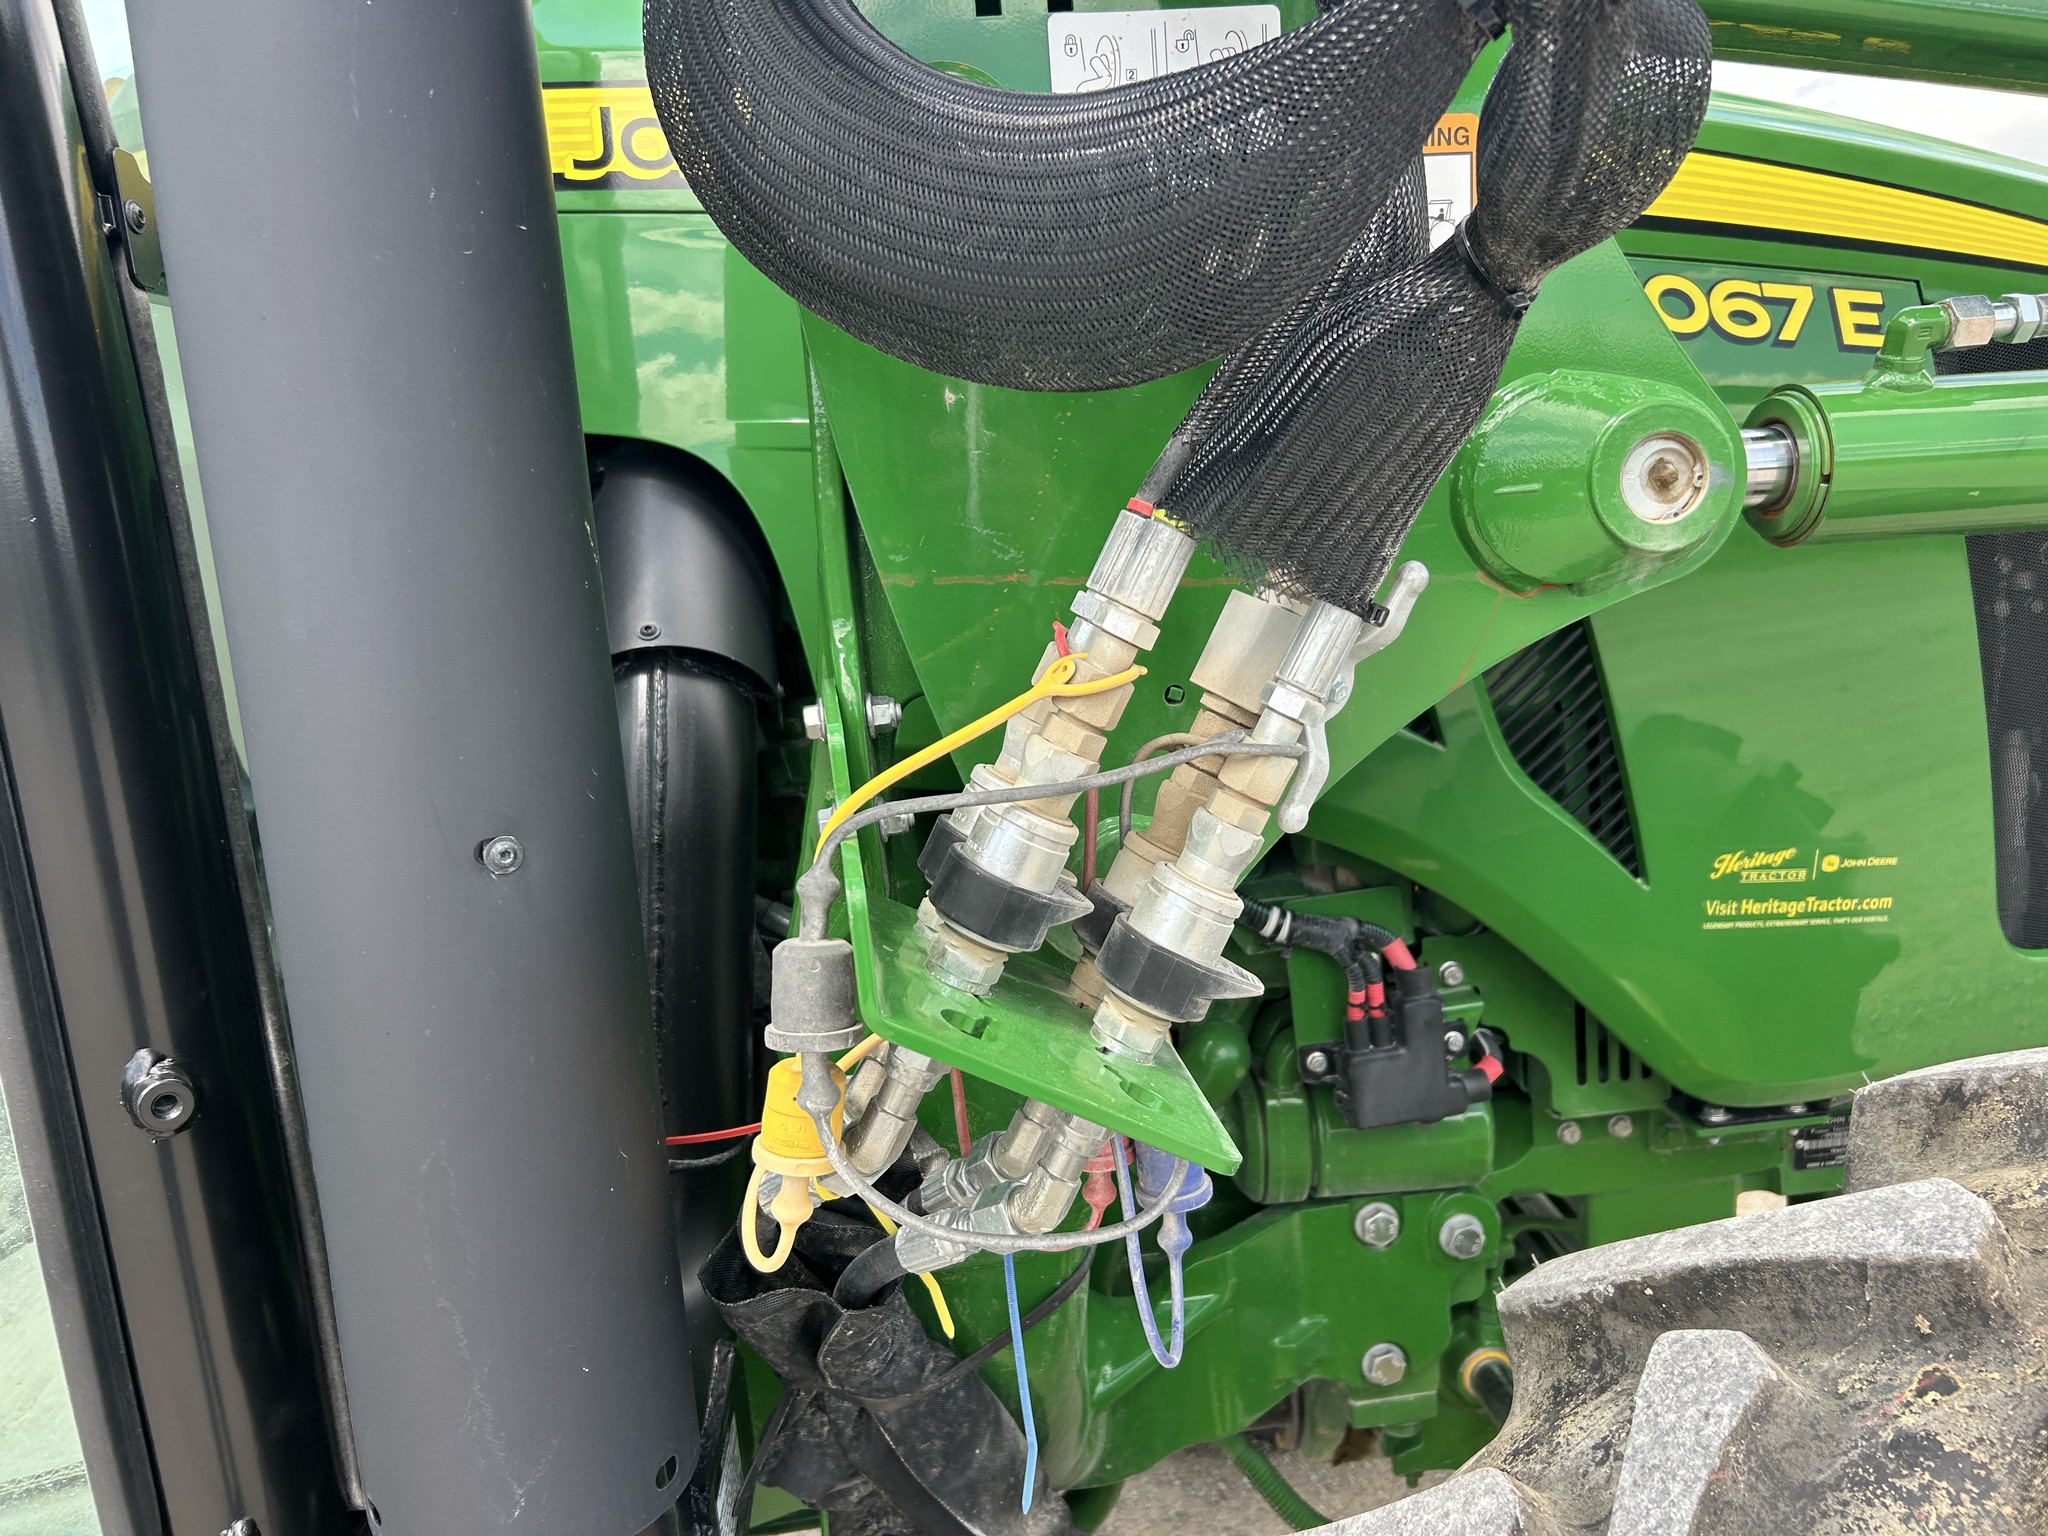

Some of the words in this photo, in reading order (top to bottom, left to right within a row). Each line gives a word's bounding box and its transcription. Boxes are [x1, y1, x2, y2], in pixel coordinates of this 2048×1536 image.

[1128, 70, 1136, 81] 2
[1426, 125, 1470, 147] ING
[1643, 273, 1814, 343] 067
[1828, 286, 1886, 351] E
[1710, 847, 1797, 880] Heritage
[1840, 858, 1866, 868] JOHN
[1867, 857, 1898, 867] DEERE
[1740, 870, 1807, 882] TRACTOR
[1705, 899, 1738, 917] Visit
[1740, 896, 1893, 918] HeritageTractor.com
